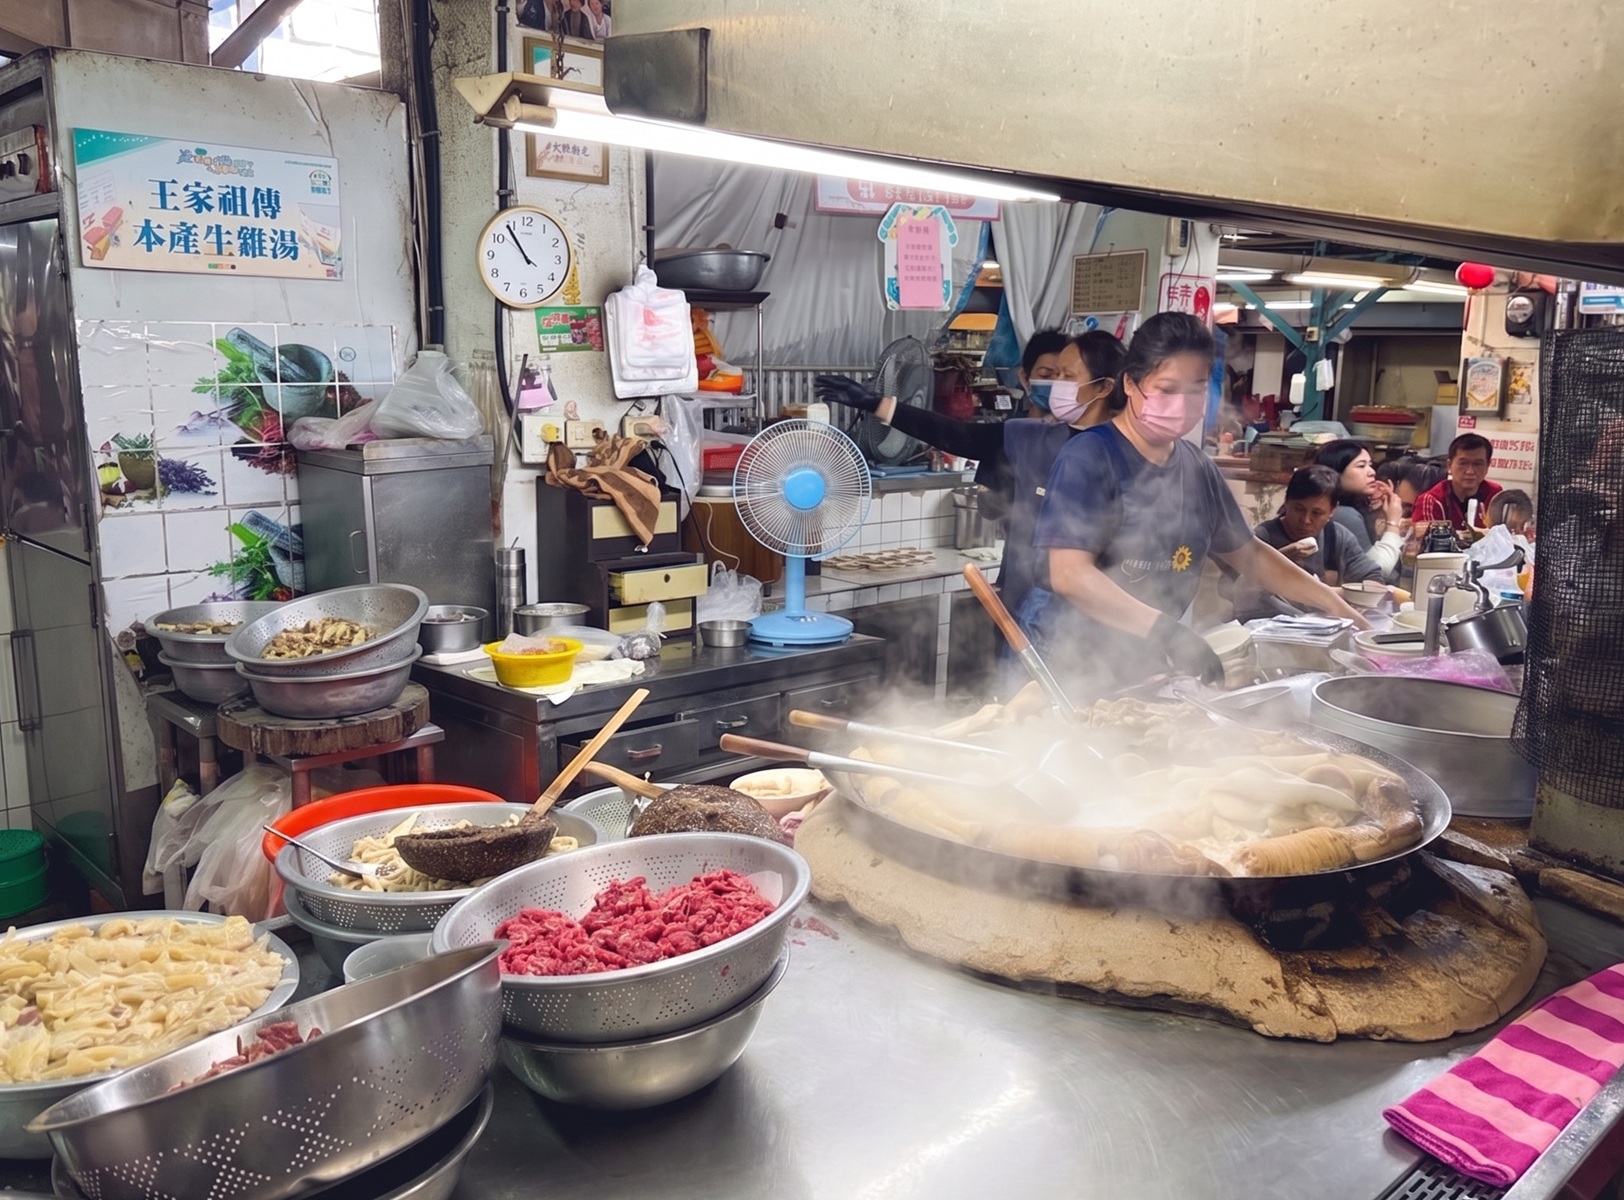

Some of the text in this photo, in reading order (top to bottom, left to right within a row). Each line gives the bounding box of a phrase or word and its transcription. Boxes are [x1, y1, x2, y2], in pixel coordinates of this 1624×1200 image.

[148, 178, 282, 220] 王家祖傳
[521, 216, 534, 227] 12
[492, 233, 505, 244] 10
[551, 237, 560, 248] 2
[486, 249, 495, 260] 9
[554, 254, 562, 265] 3
[490, 267, 499, 278] 8
[547, 272, 555, 282] 4
[503, 282, 511, 292] 7
[519, 287, 528, 298] 6
[536, 283, 544, 294] 5
